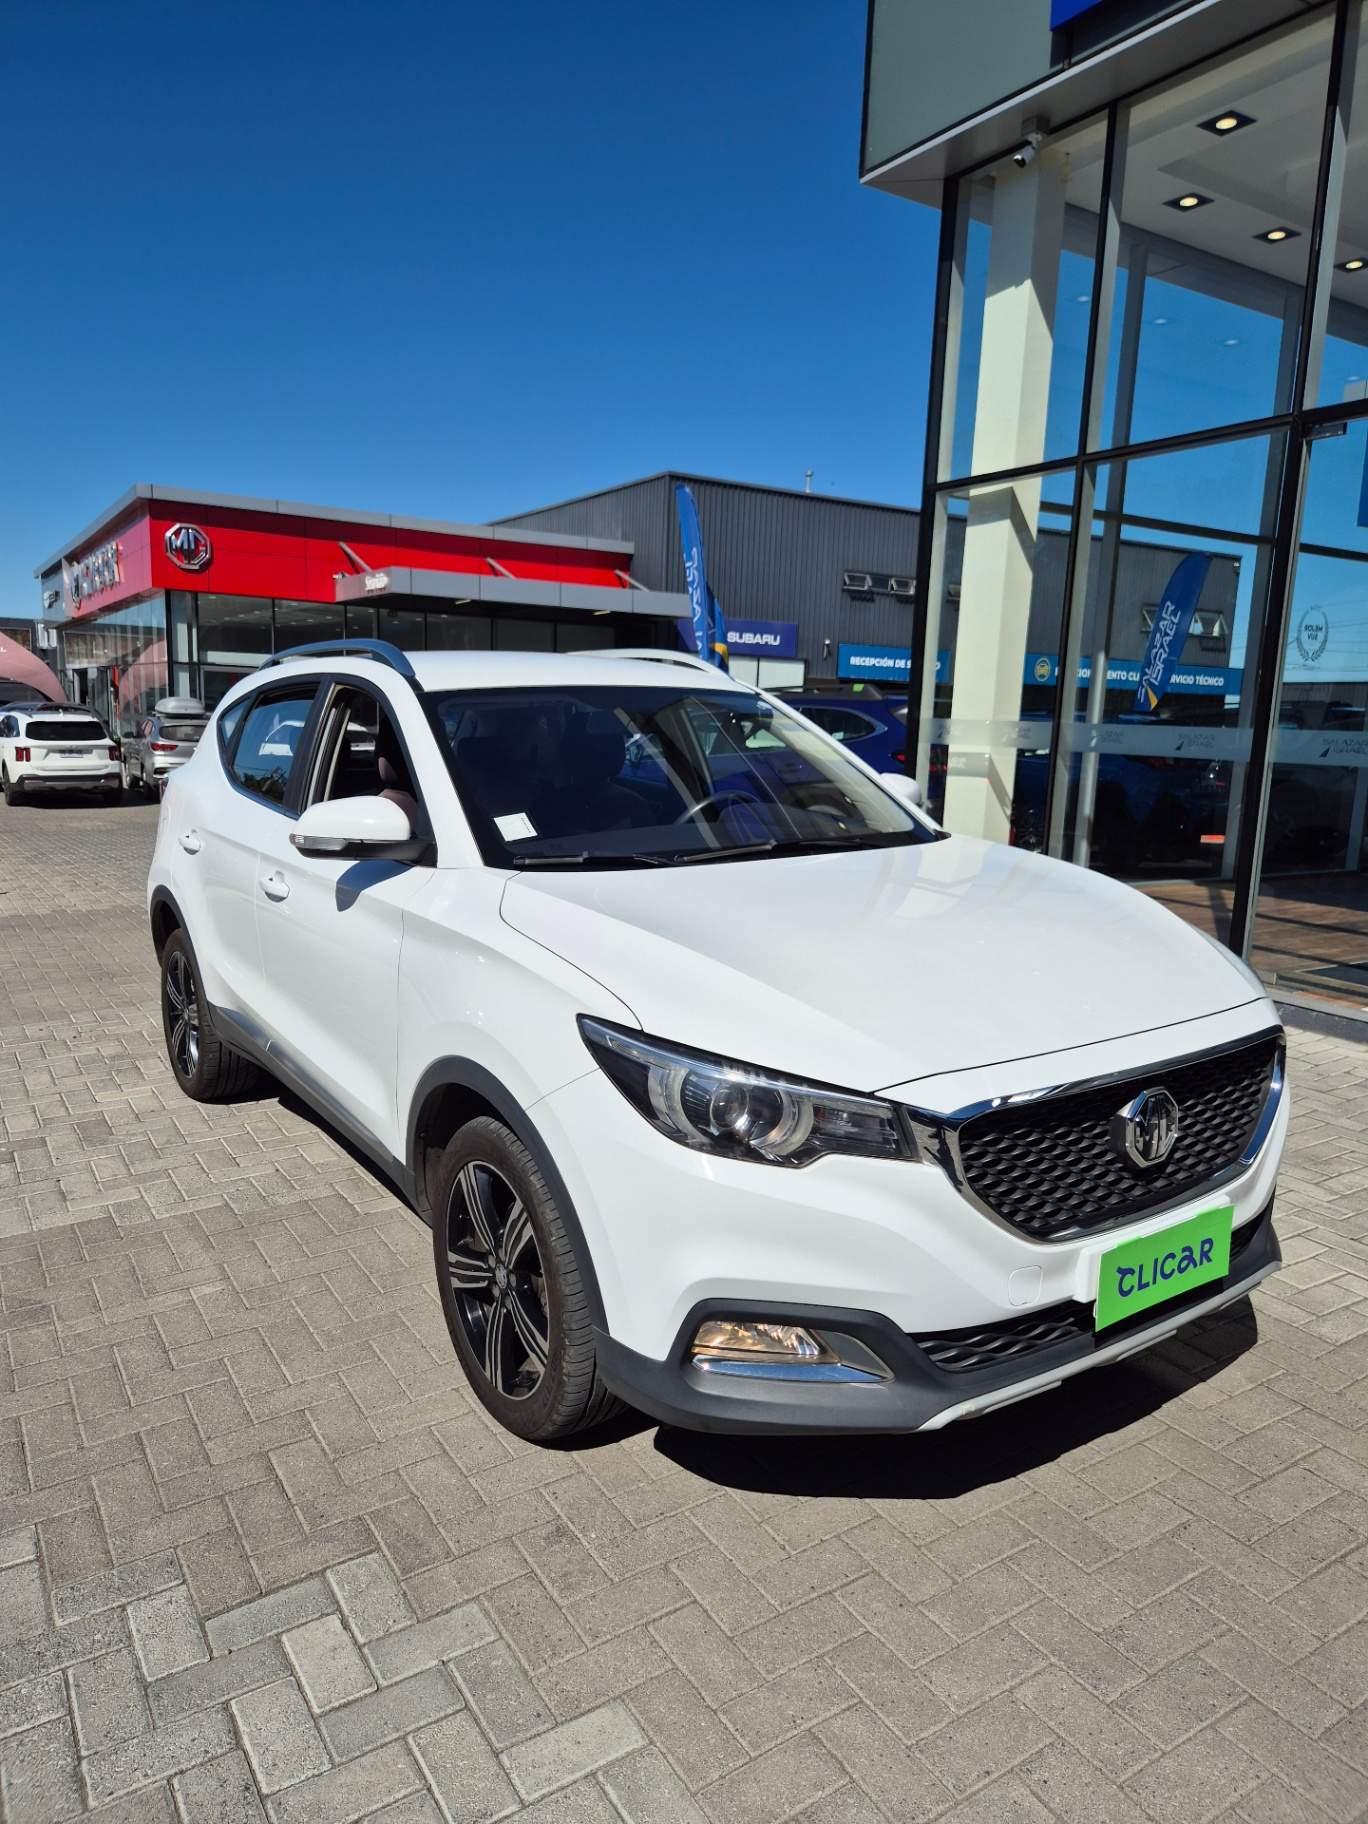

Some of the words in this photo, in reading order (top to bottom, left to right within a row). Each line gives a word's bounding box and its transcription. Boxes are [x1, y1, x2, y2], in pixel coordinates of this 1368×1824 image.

[168, 525, 208, 566] MG
[727, 631, 780, 646] SUBARU
[1150, 611, 1181, 686] ISRAEL
[849, 656, 895, 668] RECEPCIÓN
[895, 659, 906, 668] DE
[1195, 674, 1224, 686] TÉCNICO
